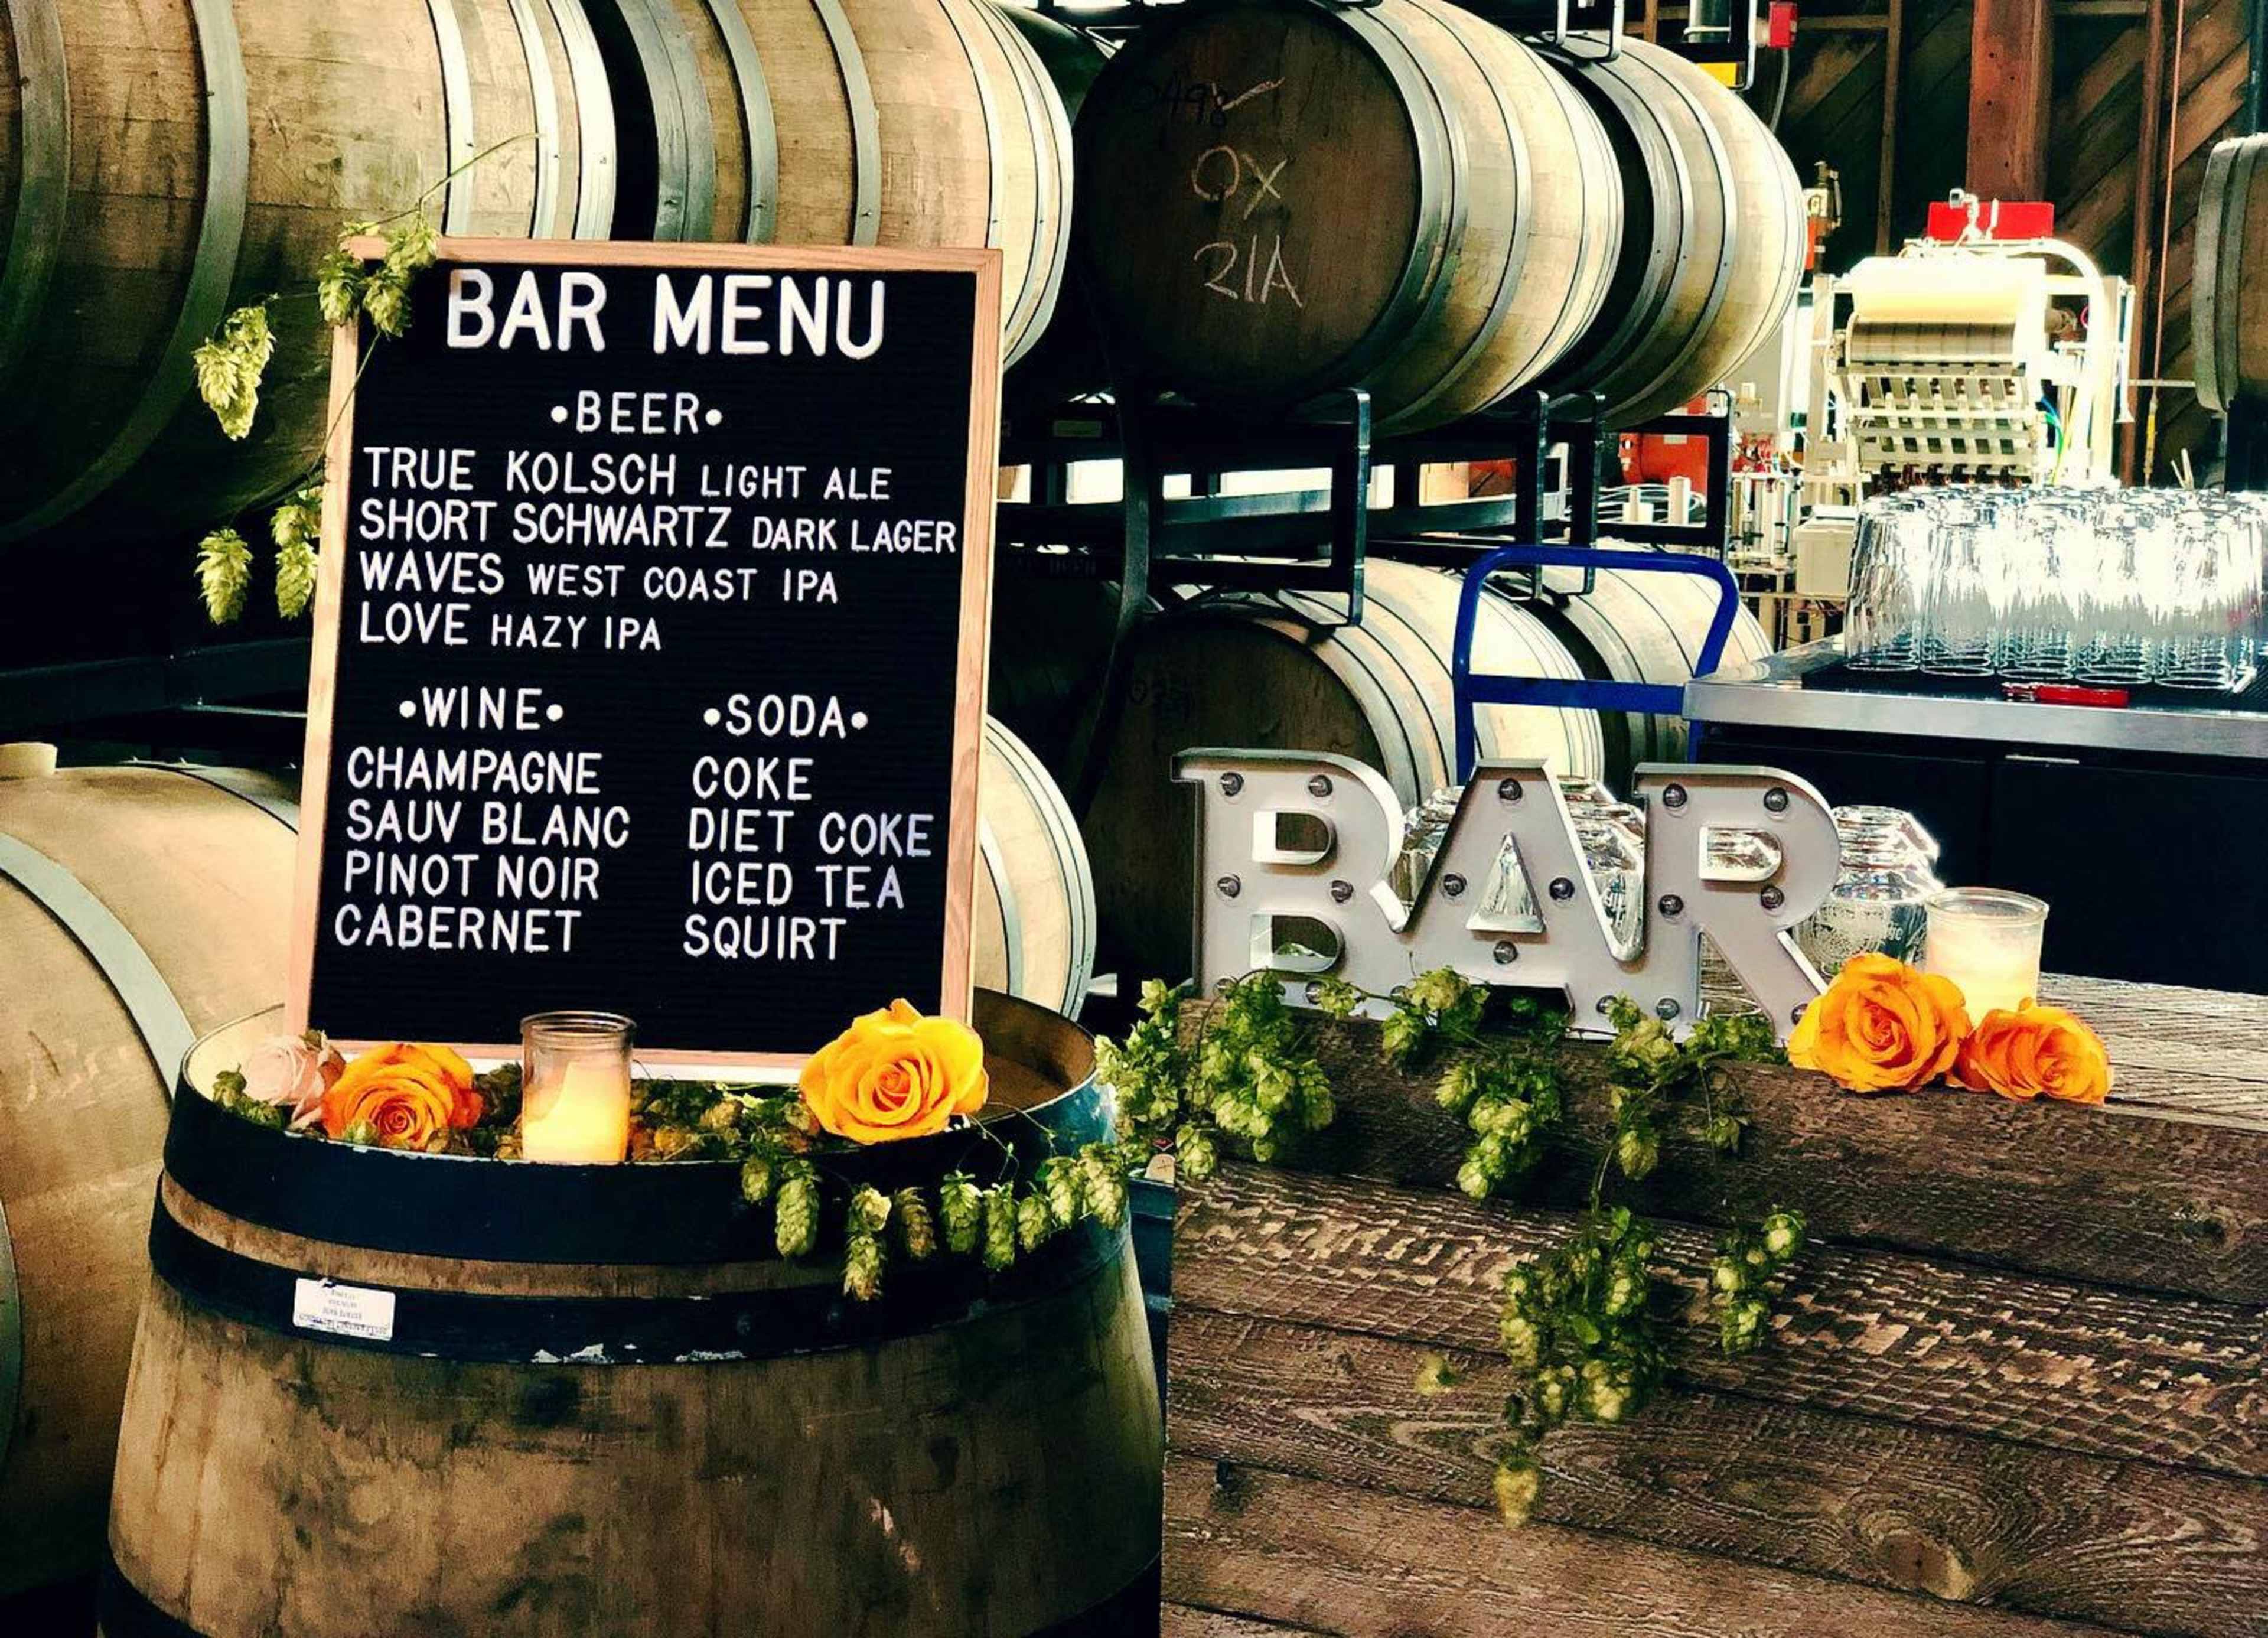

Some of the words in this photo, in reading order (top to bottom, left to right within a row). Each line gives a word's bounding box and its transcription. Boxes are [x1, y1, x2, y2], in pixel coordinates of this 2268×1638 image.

[446, 268, 607, 353] BAR
[653, 273, 885, 360] MENU
[363, 446, 477, 493] TRUE
[506, 450, 677, 497] KOLSCH
[700, 463, 807, 500] LIGHT
[823, 466, 892, 501] ALE
[359, 497, 498, 543] SHORT
[512, 502, 732, 548] SCHWARTZ
[752, 516, 838, 552] DARK
[850, 519, 957, 554] LAGER
[359, 548, 505, 596] WAVES
[526, 562, 626, 598] WEST
[643, 566, 758, 602] COAST
[783, 568, 838, 604] IPA
[359, 600, 471, 647] LOVE
[490, 613, 588, 650] HAZY
[604, 615, 662, 652] IPA
[347, 745, 603, 796] CHAMPAGNE
[692, 755, 814, 802] COKE
[346, 797, 462, 844] SAUV
[481, 800, 631, 850] BLANC
[688, 807, 795, 854] DIET
[818, 811, 934, 858] COKE
[344, 848, 480, 898] PINOT
[497, 854, 600, 902] NOIR
[692, 859, 793, 907] ICED
[814, 864, 905, 910] TEA
[1169, 745, 1843, 1043] BAR
[334, 902, 582, 954] CABERNET
[682, 913, 847, 961] SQUIRT
